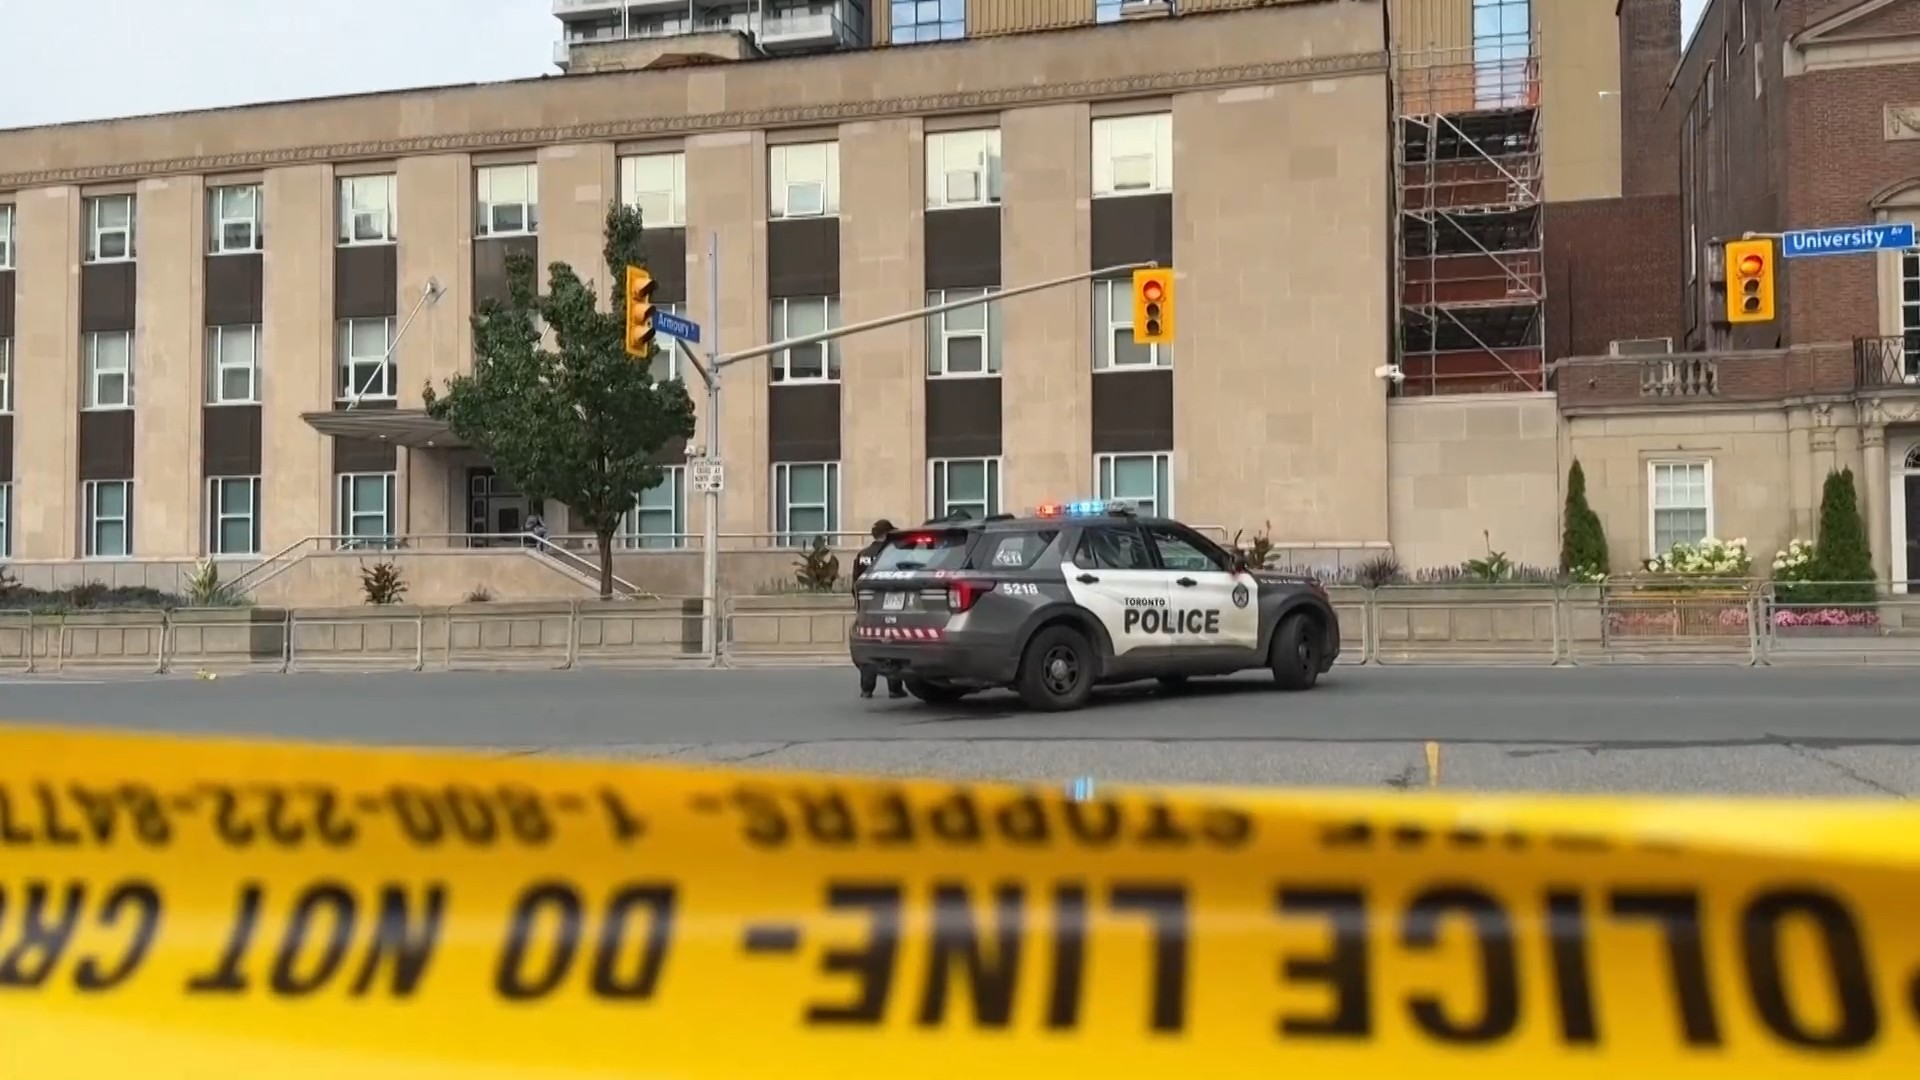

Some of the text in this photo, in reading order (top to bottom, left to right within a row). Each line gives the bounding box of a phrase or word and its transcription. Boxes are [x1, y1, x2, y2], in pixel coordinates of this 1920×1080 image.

[1793, 228, 1884, 250] University
[658, 313, 689, 337] Armoury
[1003, 583, 1039, 594] 5218
[1124, 597, 1166, 606] TORONTO
[1124, 608, 1221, 634] POLICE
[0, 877, 164, 993] CR
[183, 878, 449, 999] NOT
[495, 877, 682, 1002] DO
[1273, 880, 1920, 1057] OLICE
